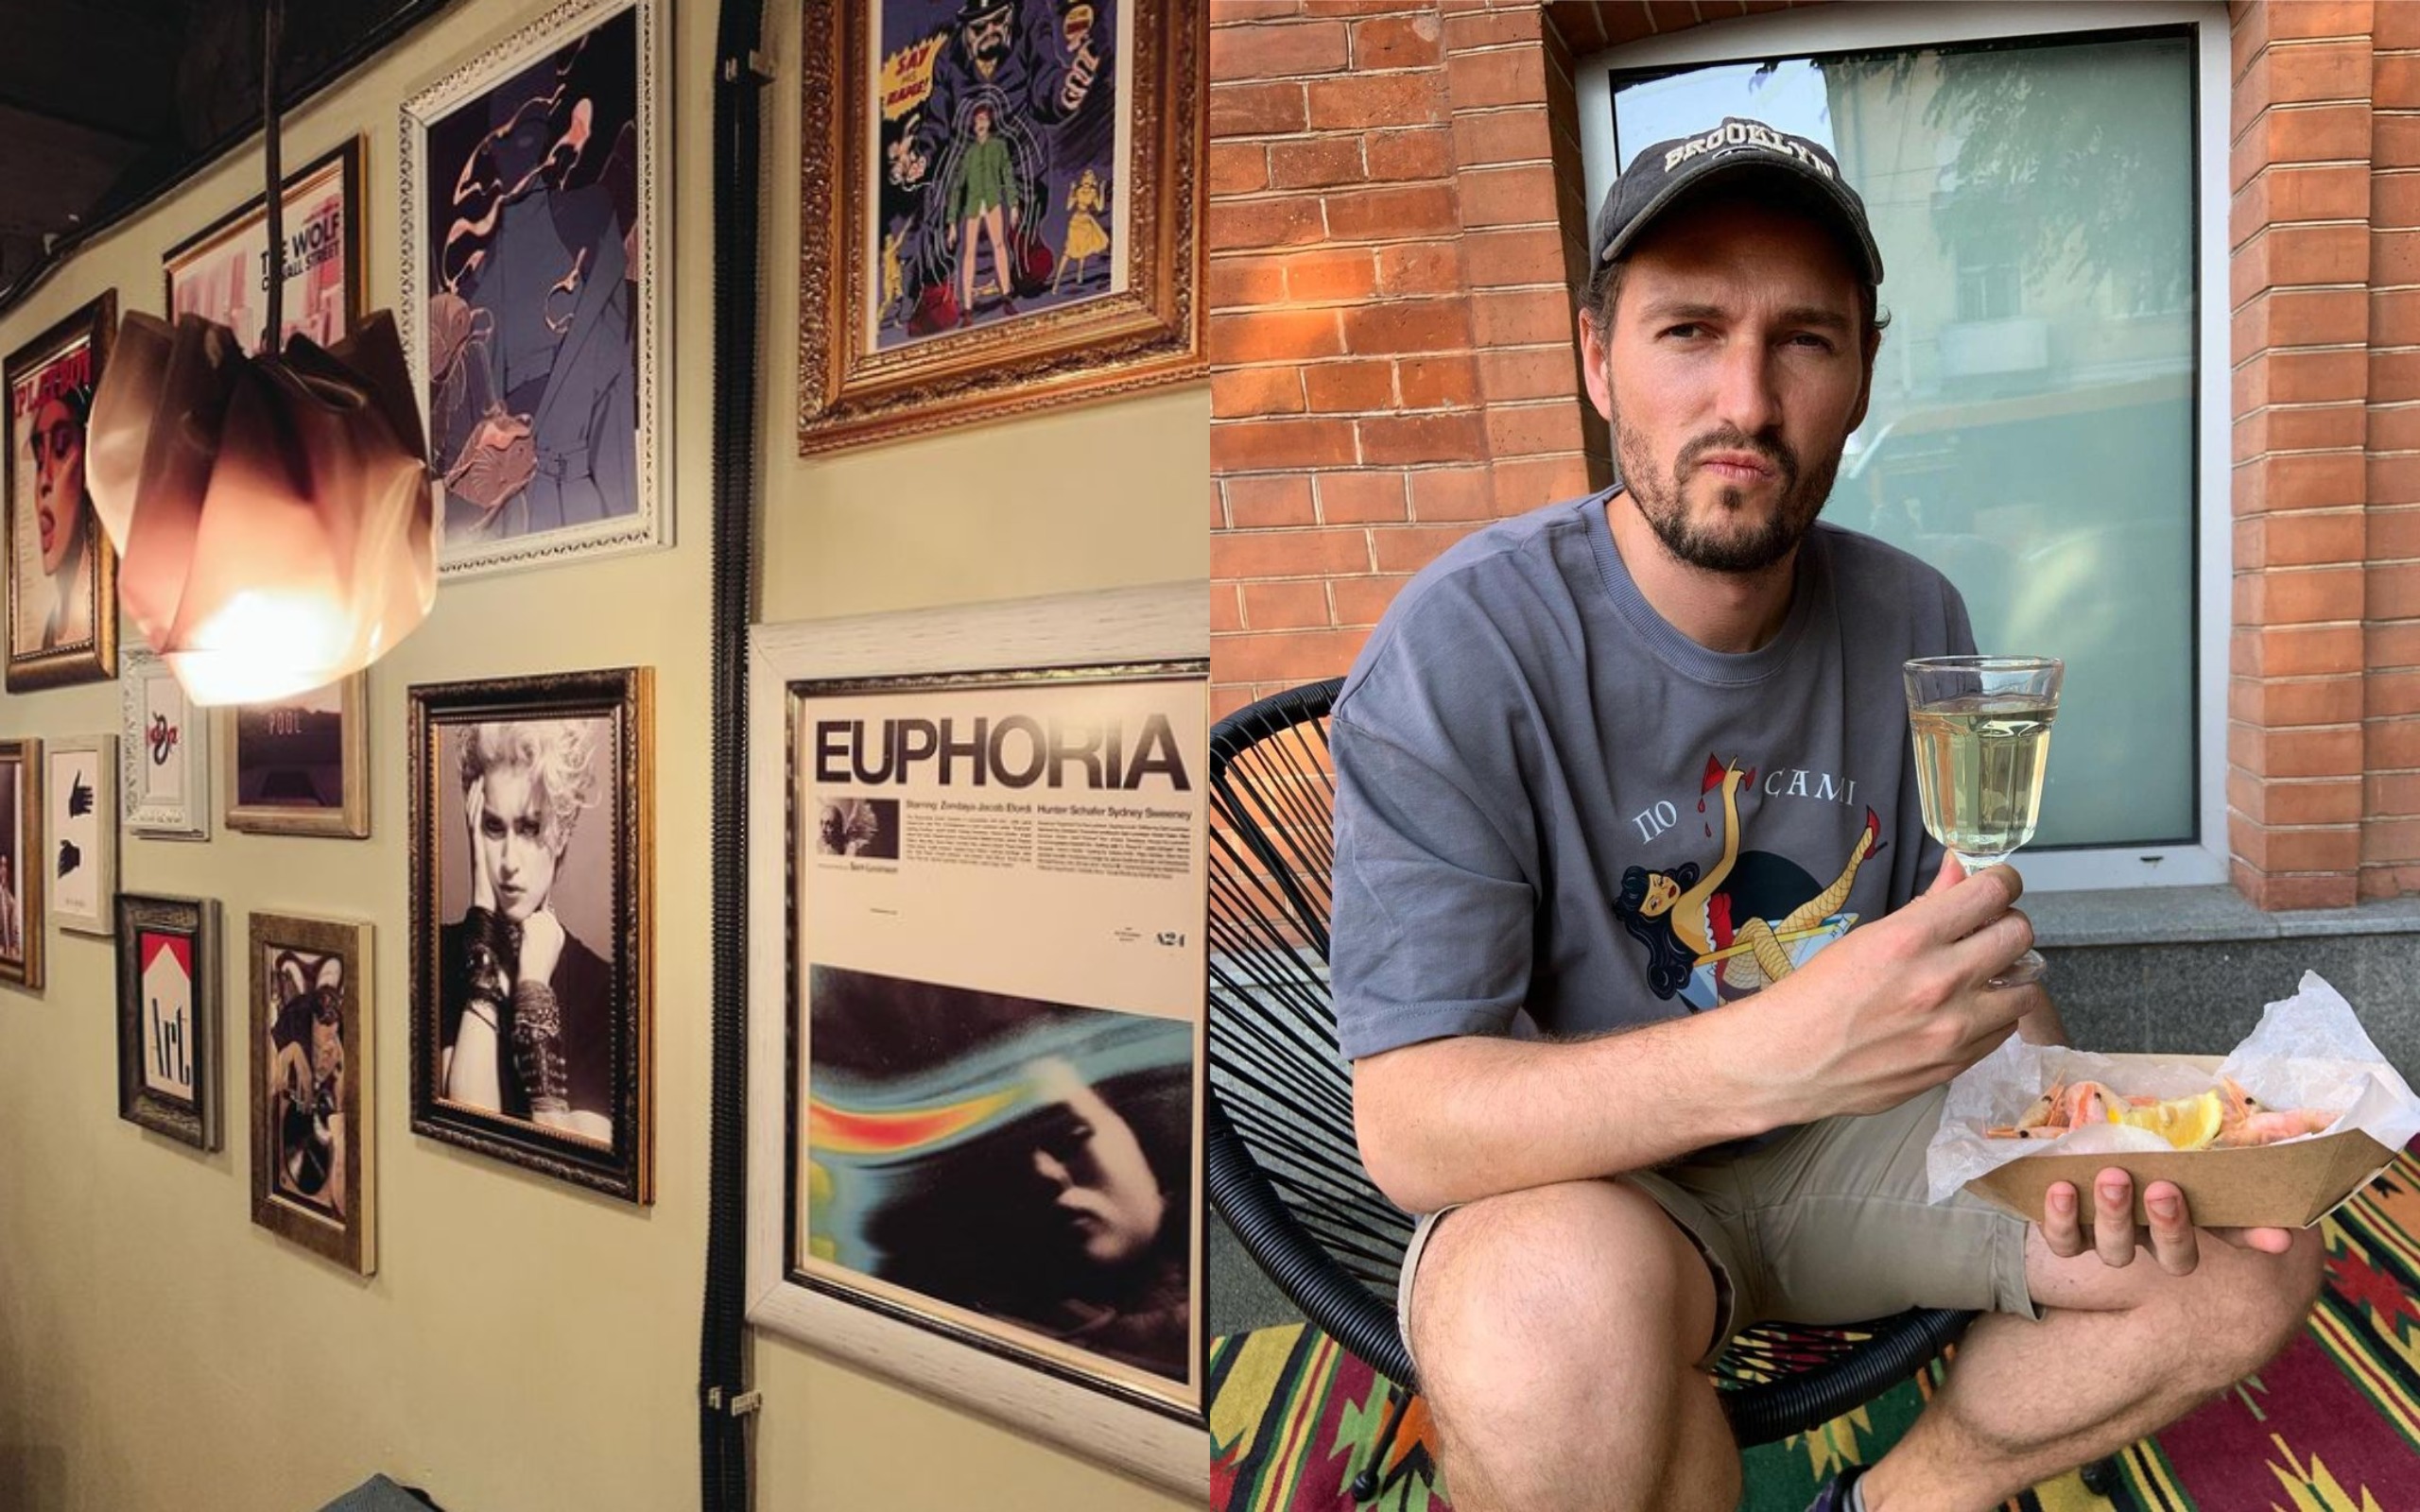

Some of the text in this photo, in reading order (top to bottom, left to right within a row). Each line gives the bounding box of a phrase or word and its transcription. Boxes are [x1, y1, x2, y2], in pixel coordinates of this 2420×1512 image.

[1664, 122, 1834, 180] BROOKLYN
[261, 240, 287, 276] TE
[292, 213, 340, 258] WOLF
[268, 711, 302, 736] POOL
[816, 713, 1192, 791] EUPHORIA
[1108, 807, 1143, 819] Sydney
[1632, 799, 1679, 845] ПО
